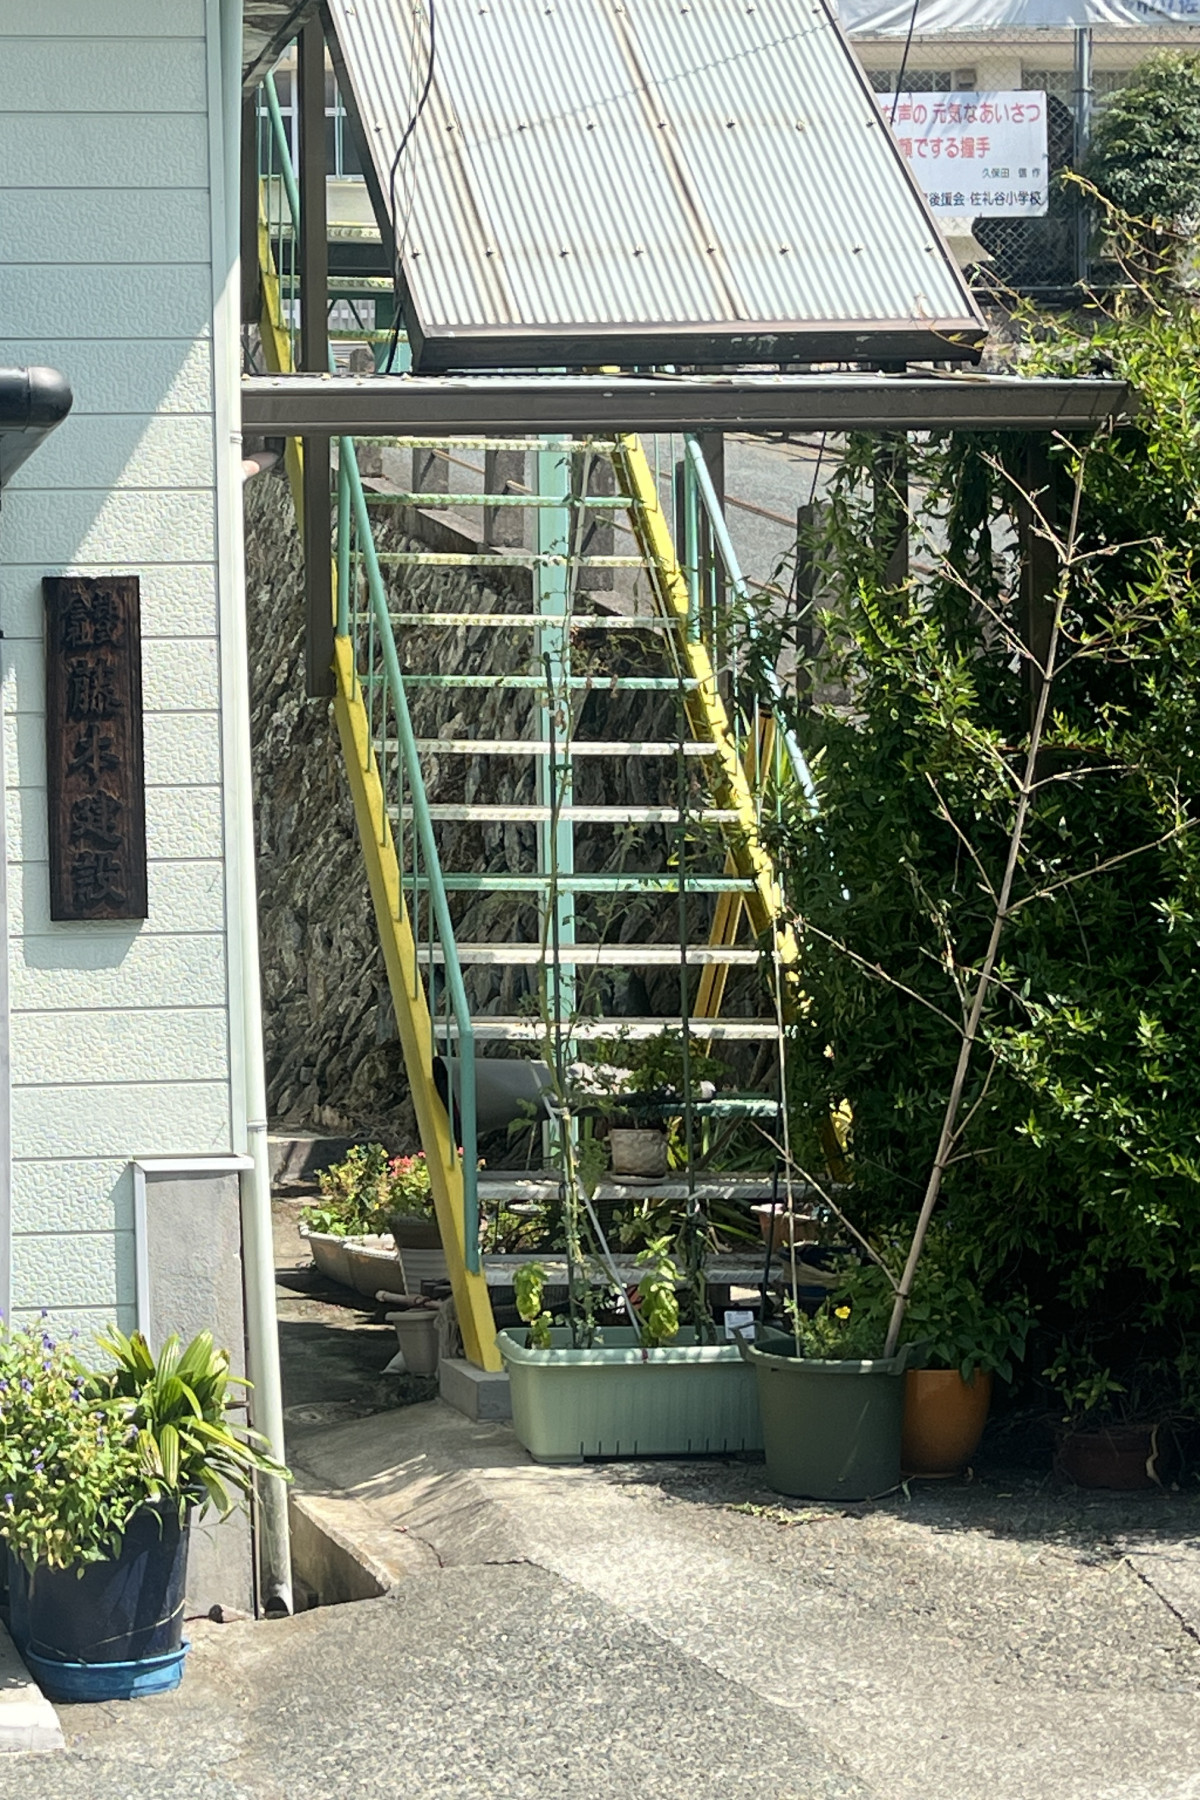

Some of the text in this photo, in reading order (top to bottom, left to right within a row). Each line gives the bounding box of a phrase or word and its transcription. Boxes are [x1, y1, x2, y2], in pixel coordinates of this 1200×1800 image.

[932, 102, 1041, 124] 元気なあいさつ
